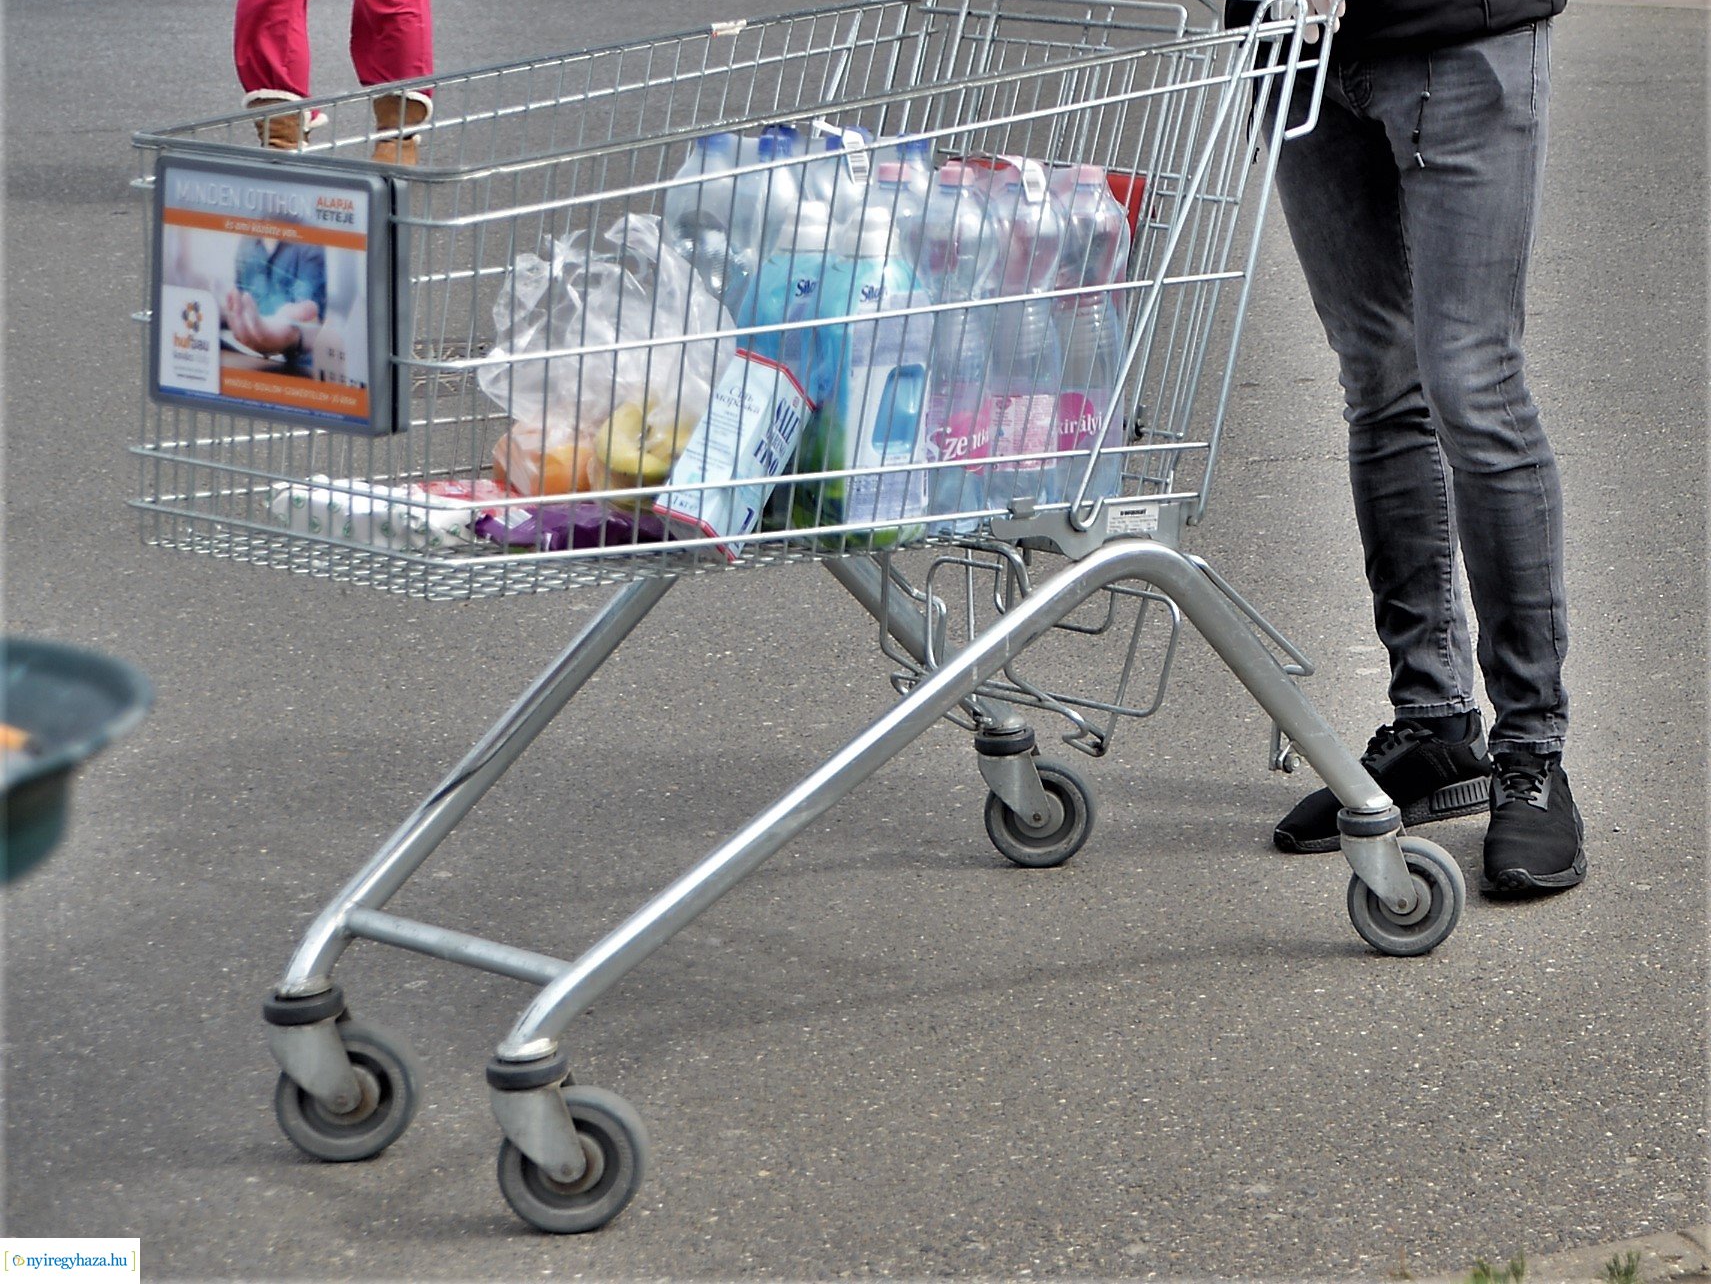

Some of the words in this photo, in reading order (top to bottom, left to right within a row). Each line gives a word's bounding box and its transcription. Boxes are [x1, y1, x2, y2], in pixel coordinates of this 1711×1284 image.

[176, 179, 240, 208] MINDEN
[316, 194, 354, 211] ALAPJA
[315, 209, 354, 225] TETEJE
[795, 279, 821, 297] Sila
